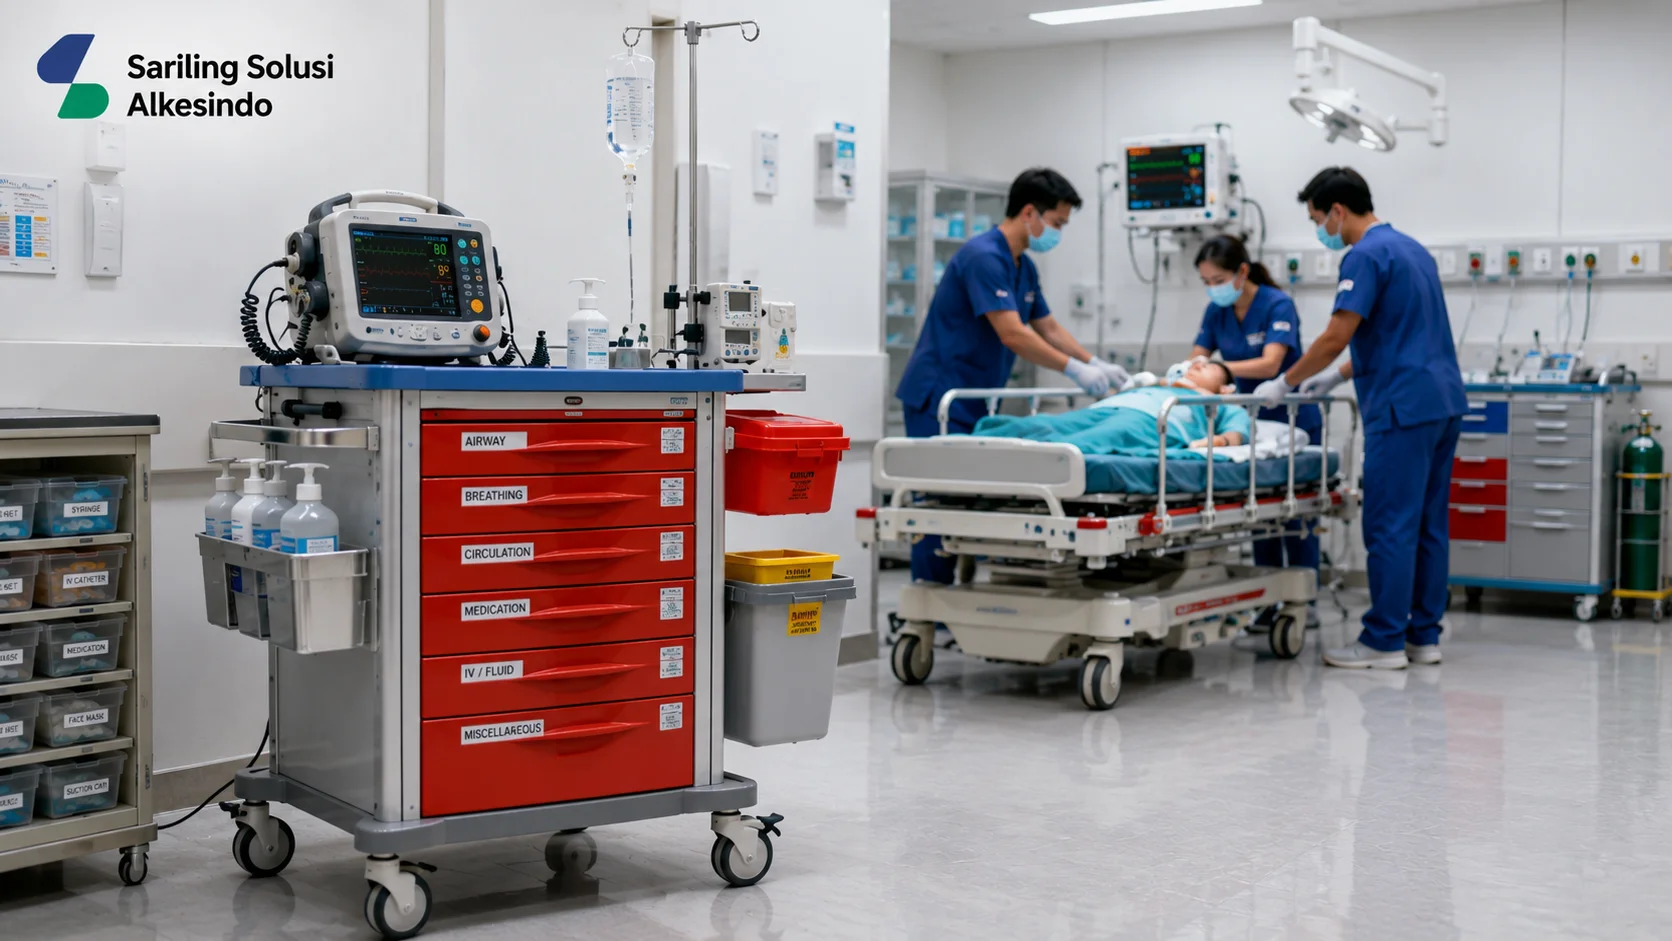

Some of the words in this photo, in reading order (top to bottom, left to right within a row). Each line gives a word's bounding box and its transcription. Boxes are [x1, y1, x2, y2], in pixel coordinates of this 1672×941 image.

[465, 436, 506, 447] AIRWAY
[465, 489, 523, 502] BREATHING
[71, 505, 101, 514] SYRINGE
[464, 547, 531, 560] CIRCULATION
[464, 603, 527, 616] MEDICATION
[464, 668, 475, 678] IV
[485, 665, 515, 677] FLUID
